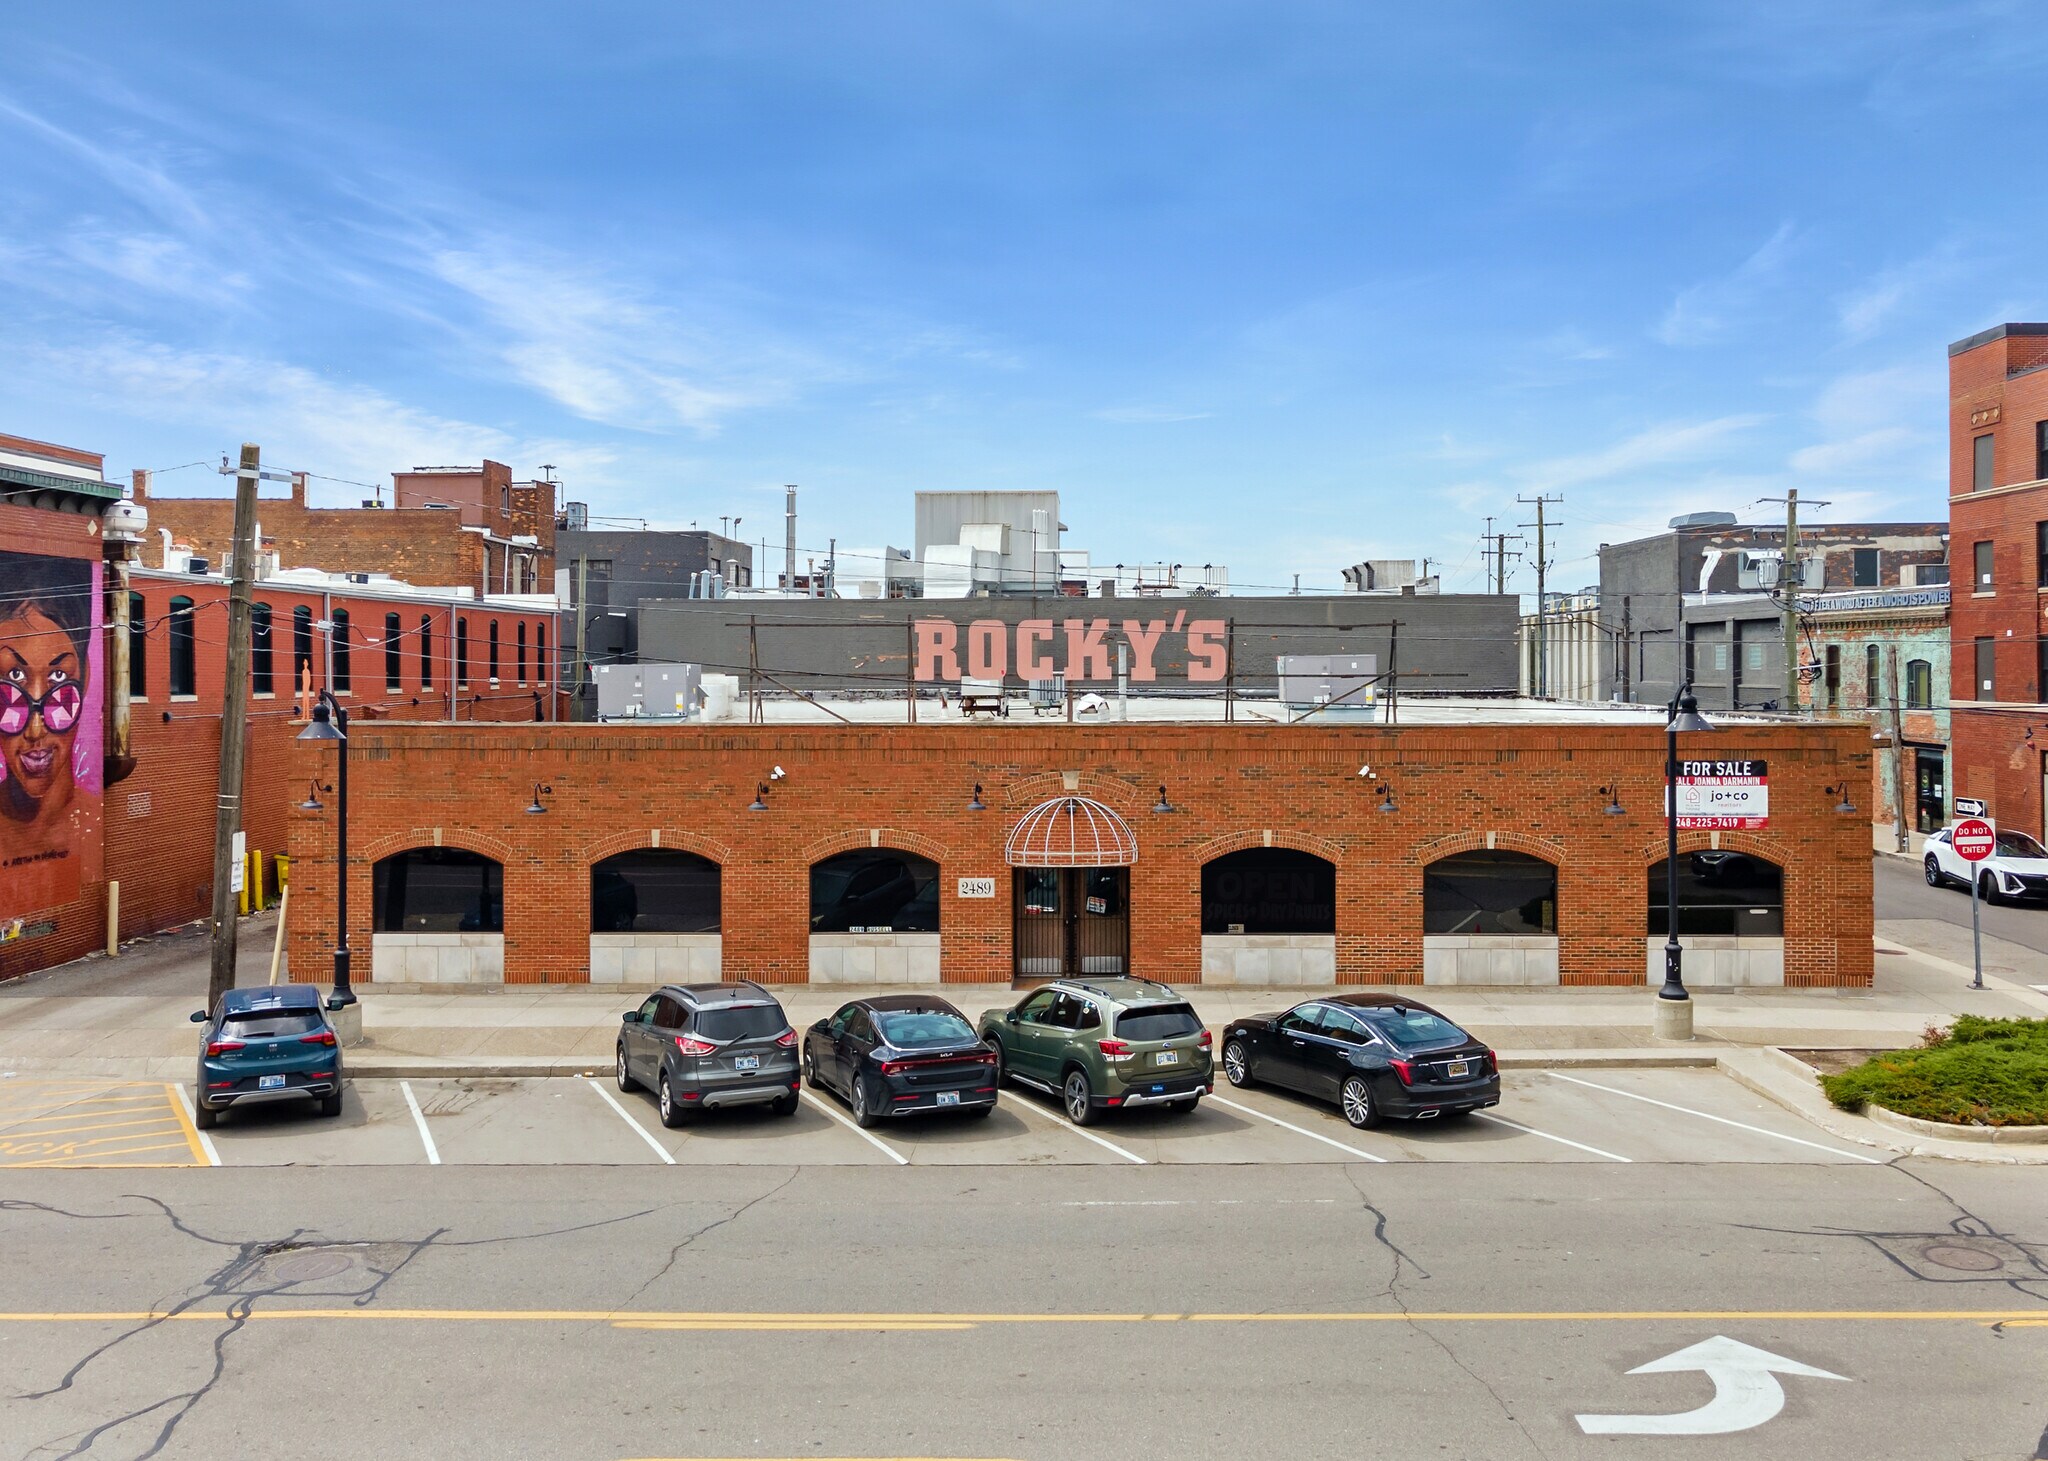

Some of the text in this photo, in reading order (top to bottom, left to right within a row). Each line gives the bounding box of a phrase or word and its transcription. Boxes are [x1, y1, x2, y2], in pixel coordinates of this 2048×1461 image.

[1836, 597, 1855, 610] WORD
[1856, 596, 1878, 608] AFTER
[1884, 594, 1908, 606] WORD
[1909, 593, 1918, 605] IS
[1919, 590, 1950, 604] POWER
[914, 609, 1227, 681] ROCKY'S
[1683, 762, 1752, 776] FOR SALE
[1693, 777, 1720, 786] JOANNA
[1723, 777, 1760, 786] DARMANIN
[1676, 818, 1738, 828] 248-225-7419
[1958, 827, 1988, 836] DO NOT
[1962, 846, 1987, 854] ENTER
[961, 881, 992, 895] 2489
[1216, 871, 1315, 900] OPEN
